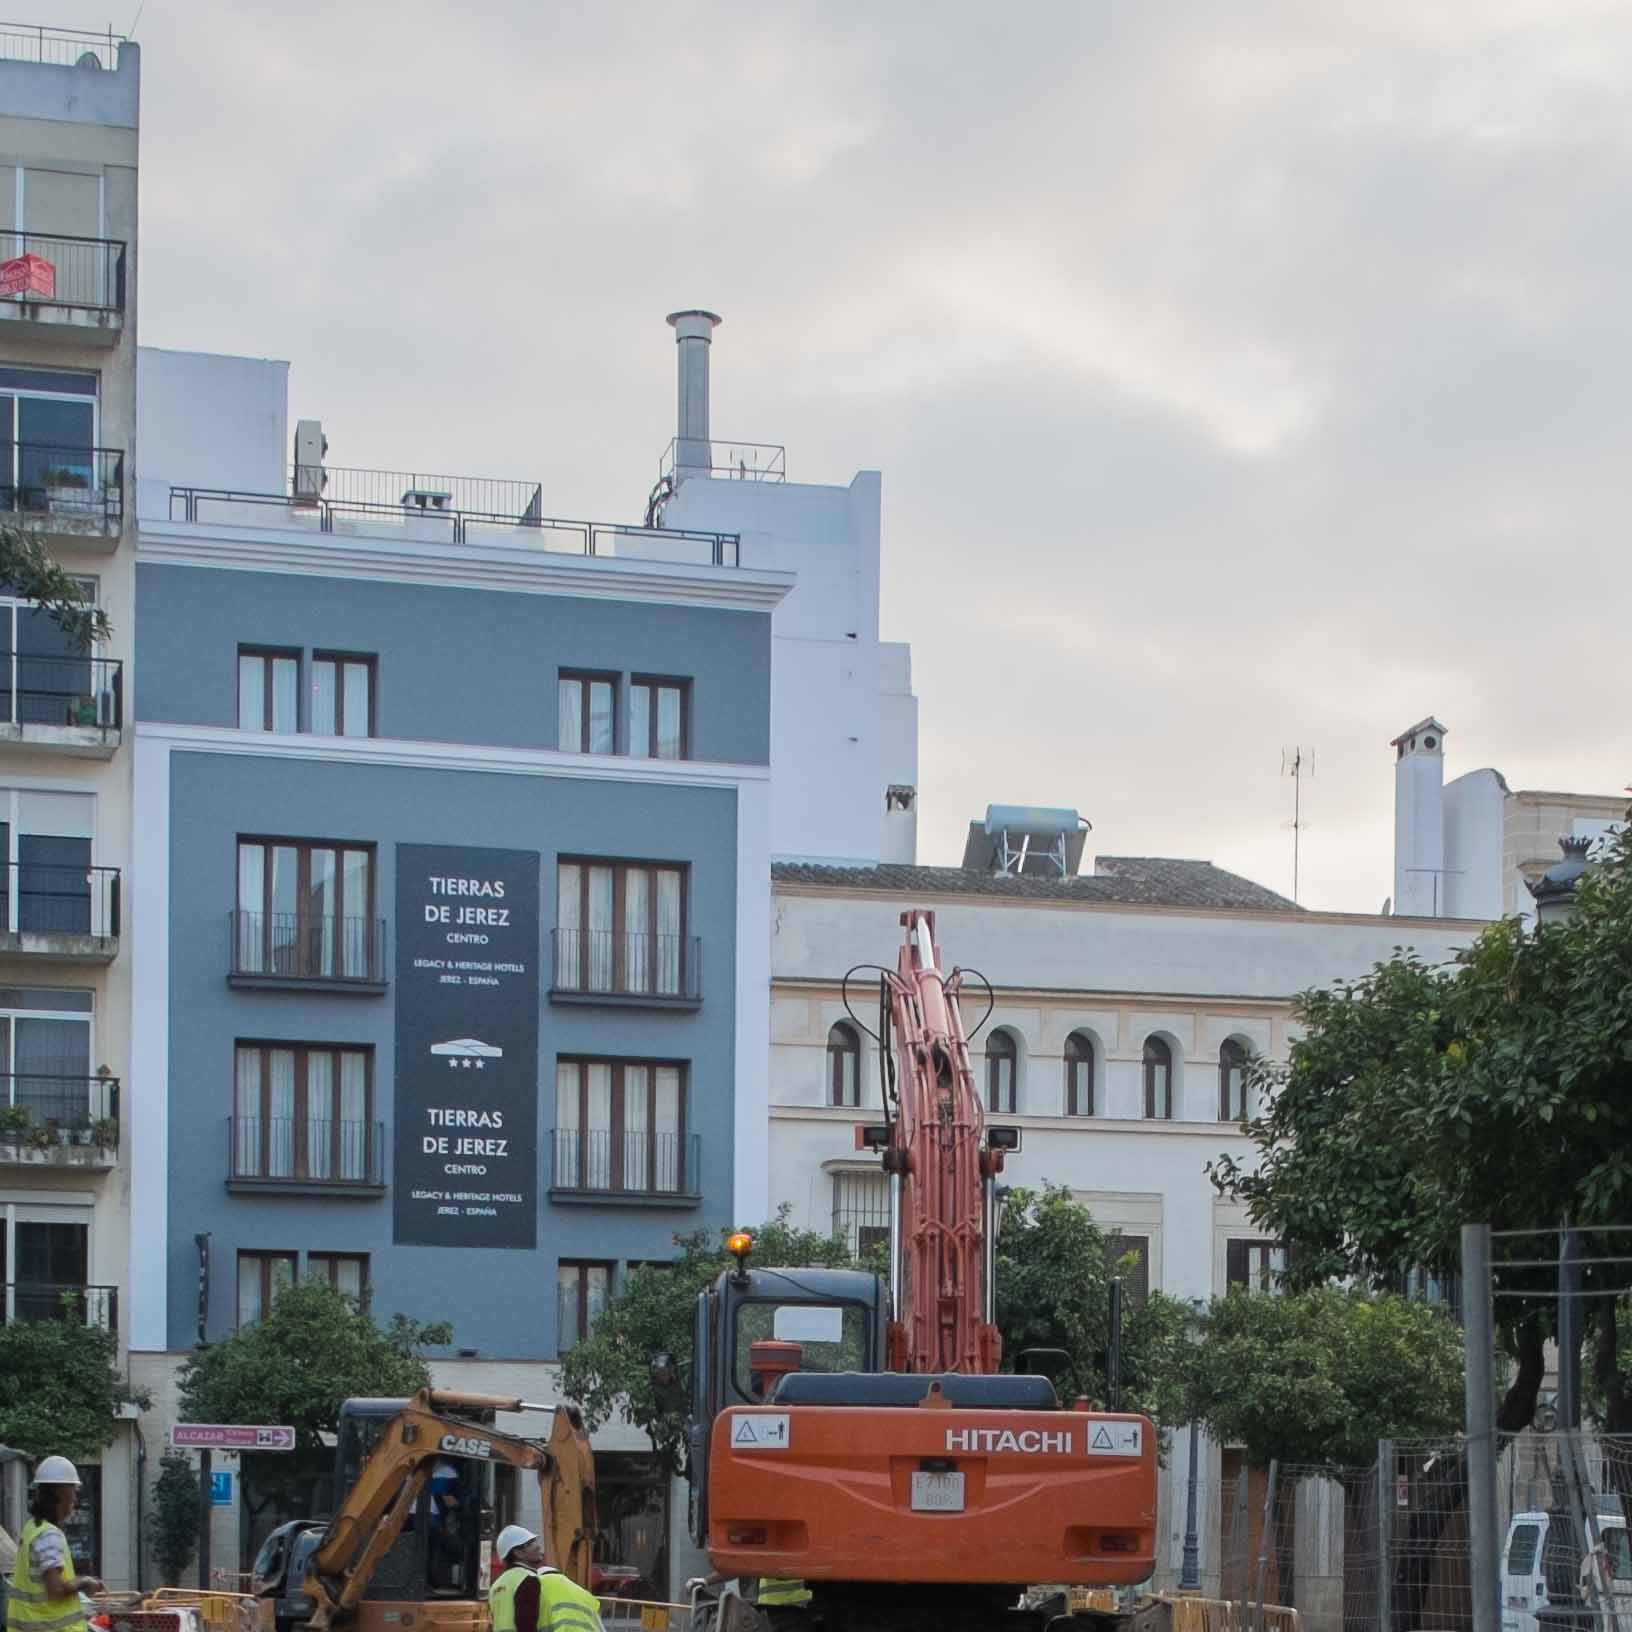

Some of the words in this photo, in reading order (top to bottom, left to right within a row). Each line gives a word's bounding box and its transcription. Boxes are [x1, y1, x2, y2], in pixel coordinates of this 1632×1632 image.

[429, 877, 505, 898] TIERRAS
[425, 905, 451, 923] DE
[456, 906, 510, 926] JEREZ
[446, 933, 489, 945] CENTRO
[414, 959, 446, 969] LEGACY
[447, 961, 454, 970] &
[455, 961, 492, 972] HERITAGE
[494, 963, 525, 973] HOTELS
[439, 975, 462, 984] JEREZ
[468, 976, 500, 986] ESPAÑA
[427, 1108, 503, 1128] TIERRAS
[423, 1137, 449, 1154] DE
[454, 1138, 508, 1156] JEREZ
[444, 1164, 487, 1175] CENTRO
[411, 1190, 443, 1200] LEGACY
[445, 1192, 451, 1200] &
[453, 1192, 490, 1202] HERITAGE
[492, 1193, 523, 1203] HOTELS
[437, 1206, 459, 1215] JEREZ
[466, 1206, 497, 1216] ESPAÑA
[441, 1433, 491, 1458] CASE
[945, 1428, 1071, 1453] HITACHI
